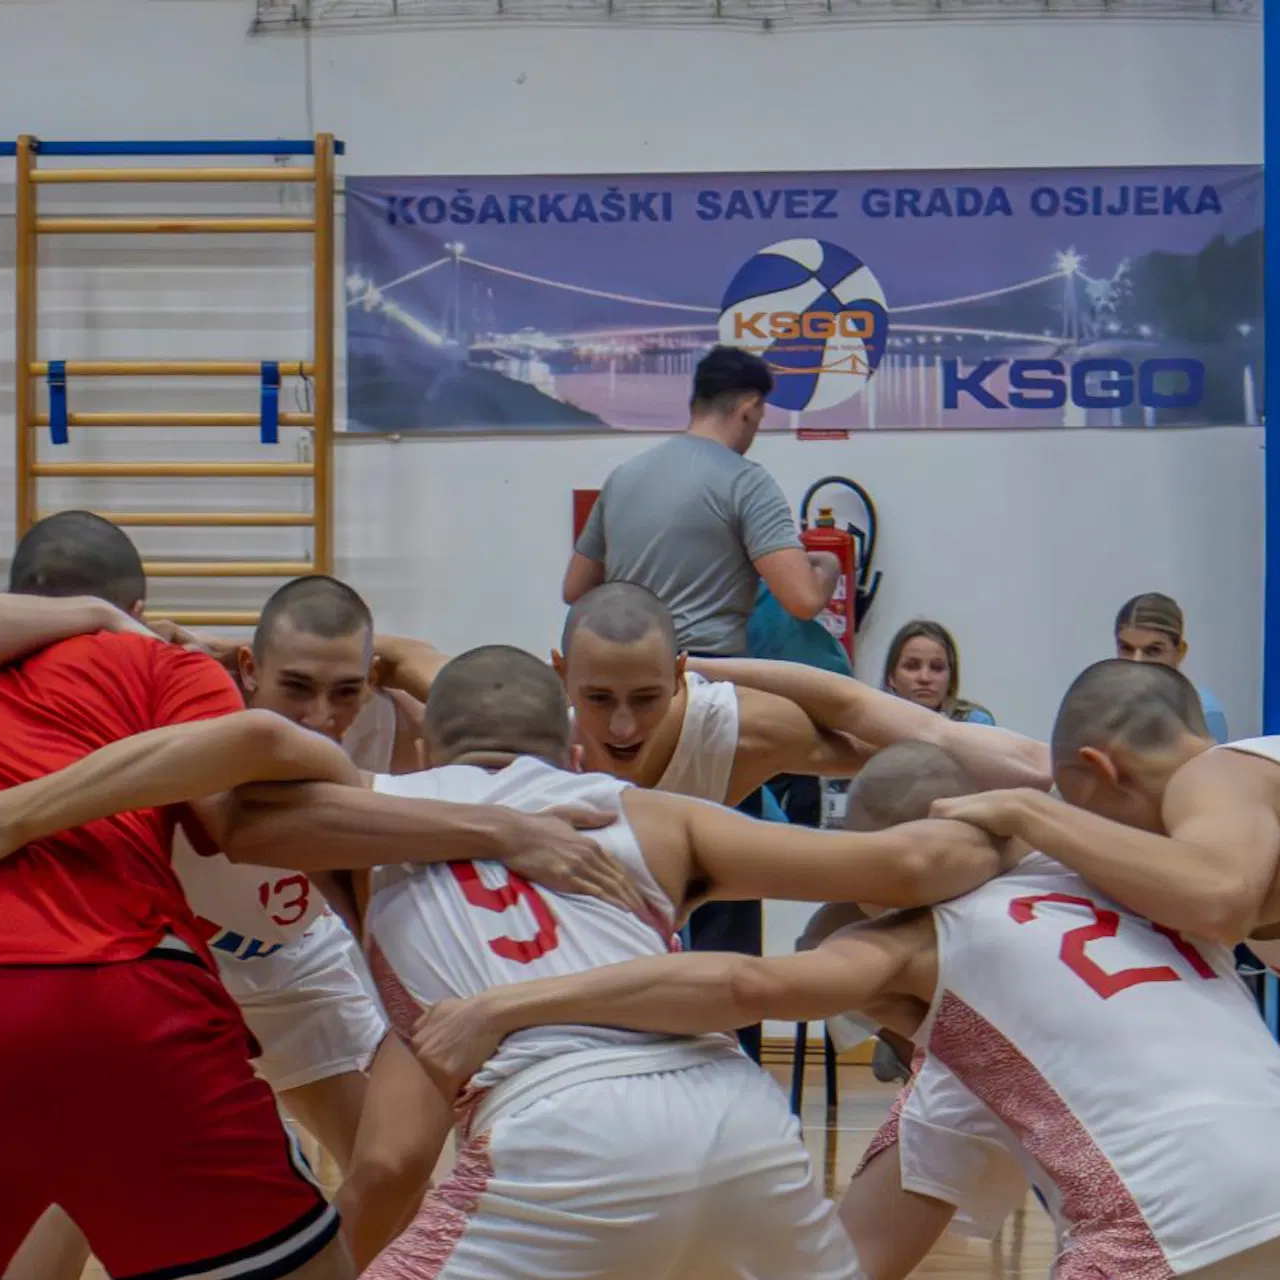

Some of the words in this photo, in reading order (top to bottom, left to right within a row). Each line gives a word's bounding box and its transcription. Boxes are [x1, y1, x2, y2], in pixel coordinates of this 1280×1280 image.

[385, 186, 673, 225] KOŠARKAŠKI
[695, 188, 840, 221] SAVEZ
[860, 186, 1013, 219] GRADA
[1029, 184, 1224, 218] OSIJEKA
[733, 310, 875, 340] KSGO
[942, 357, 1206, 410] KSGO
